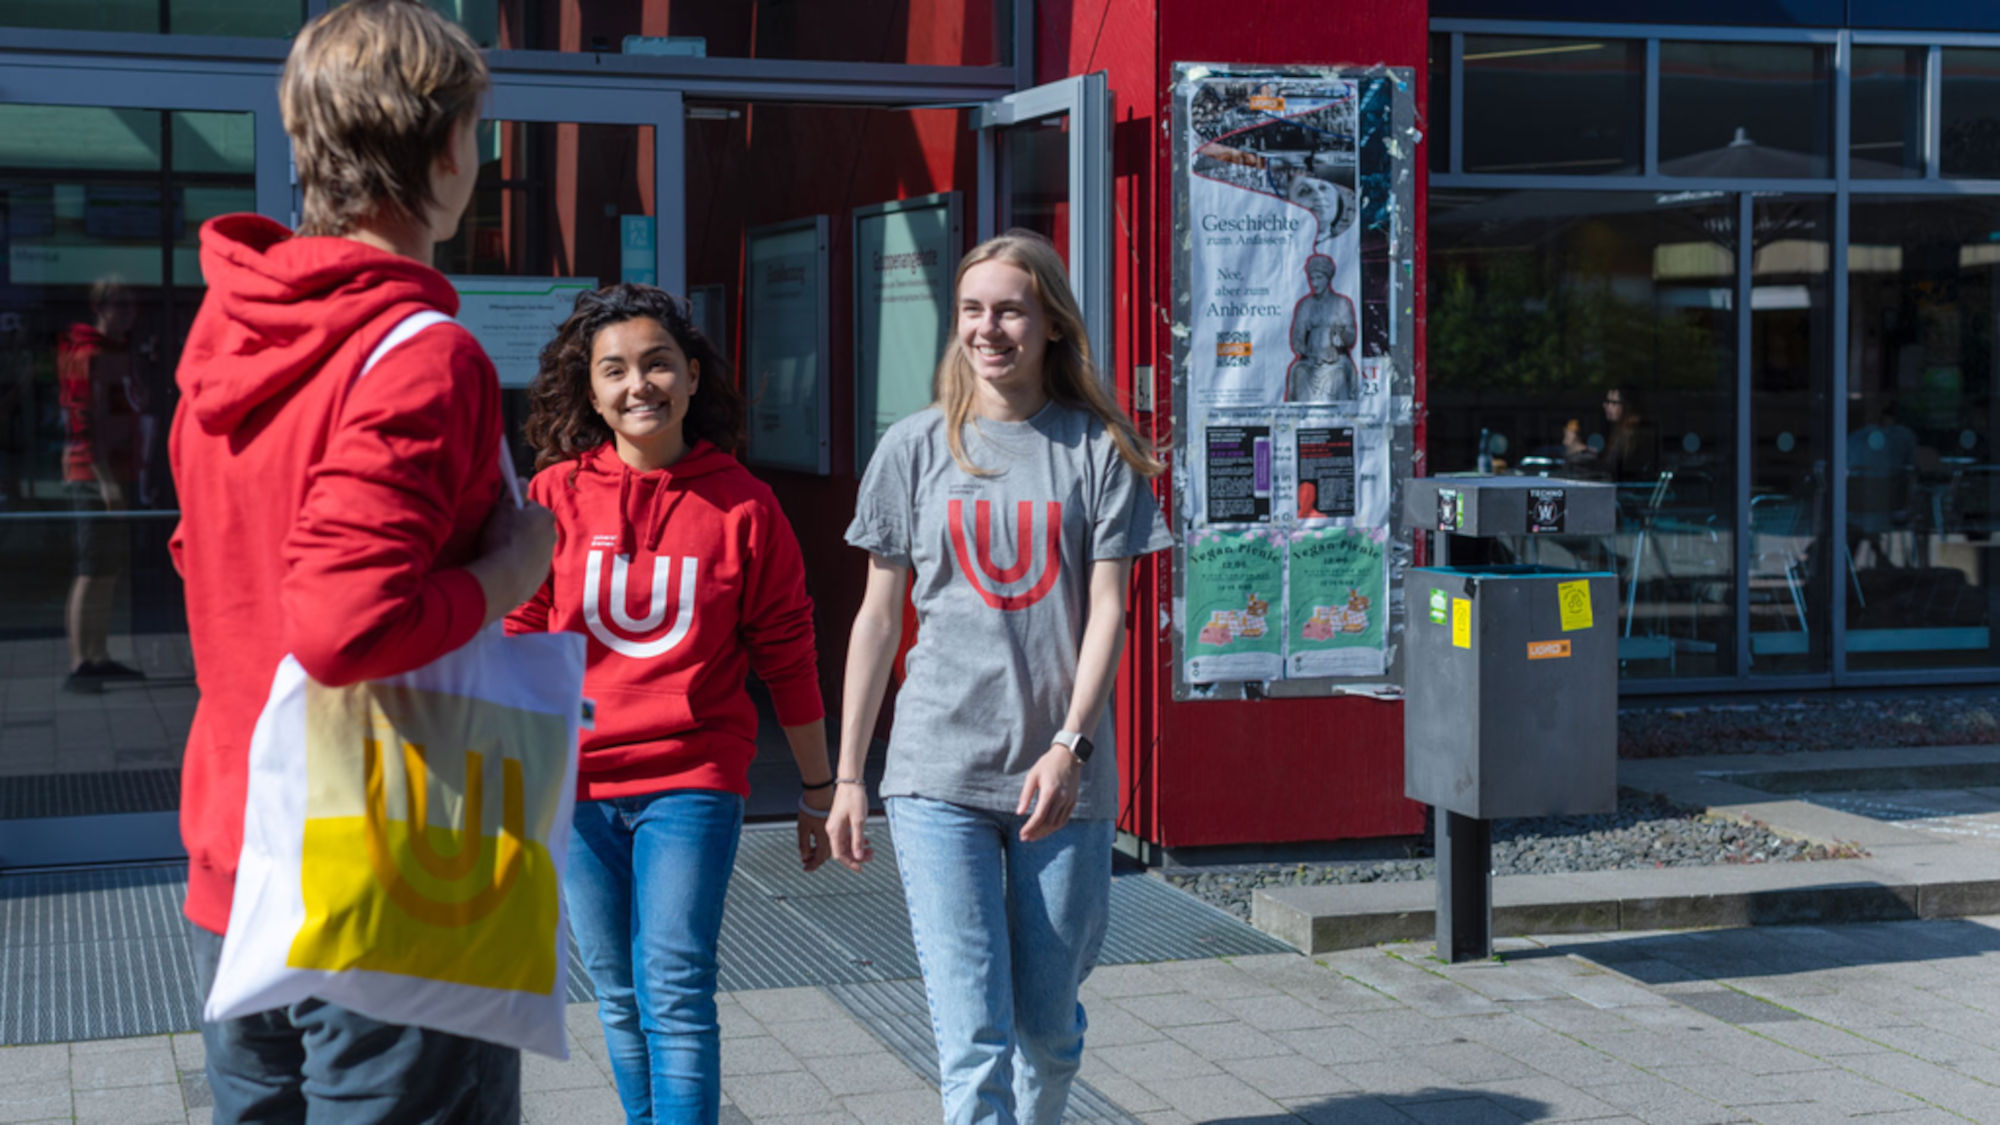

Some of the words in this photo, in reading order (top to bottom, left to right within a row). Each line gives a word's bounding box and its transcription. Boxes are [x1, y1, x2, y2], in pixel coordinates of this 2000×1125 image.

[1202, 214, 1299, 232] Geschichte
[1207, 237, 1232, 245] zum
[1217, 268, 1244, 281] Nee,
[1215, 286, 1240, 296] aber
[1206, 302, 1281, 317] Anhören:
[1530, 489, 1563, 498] TECHNO
